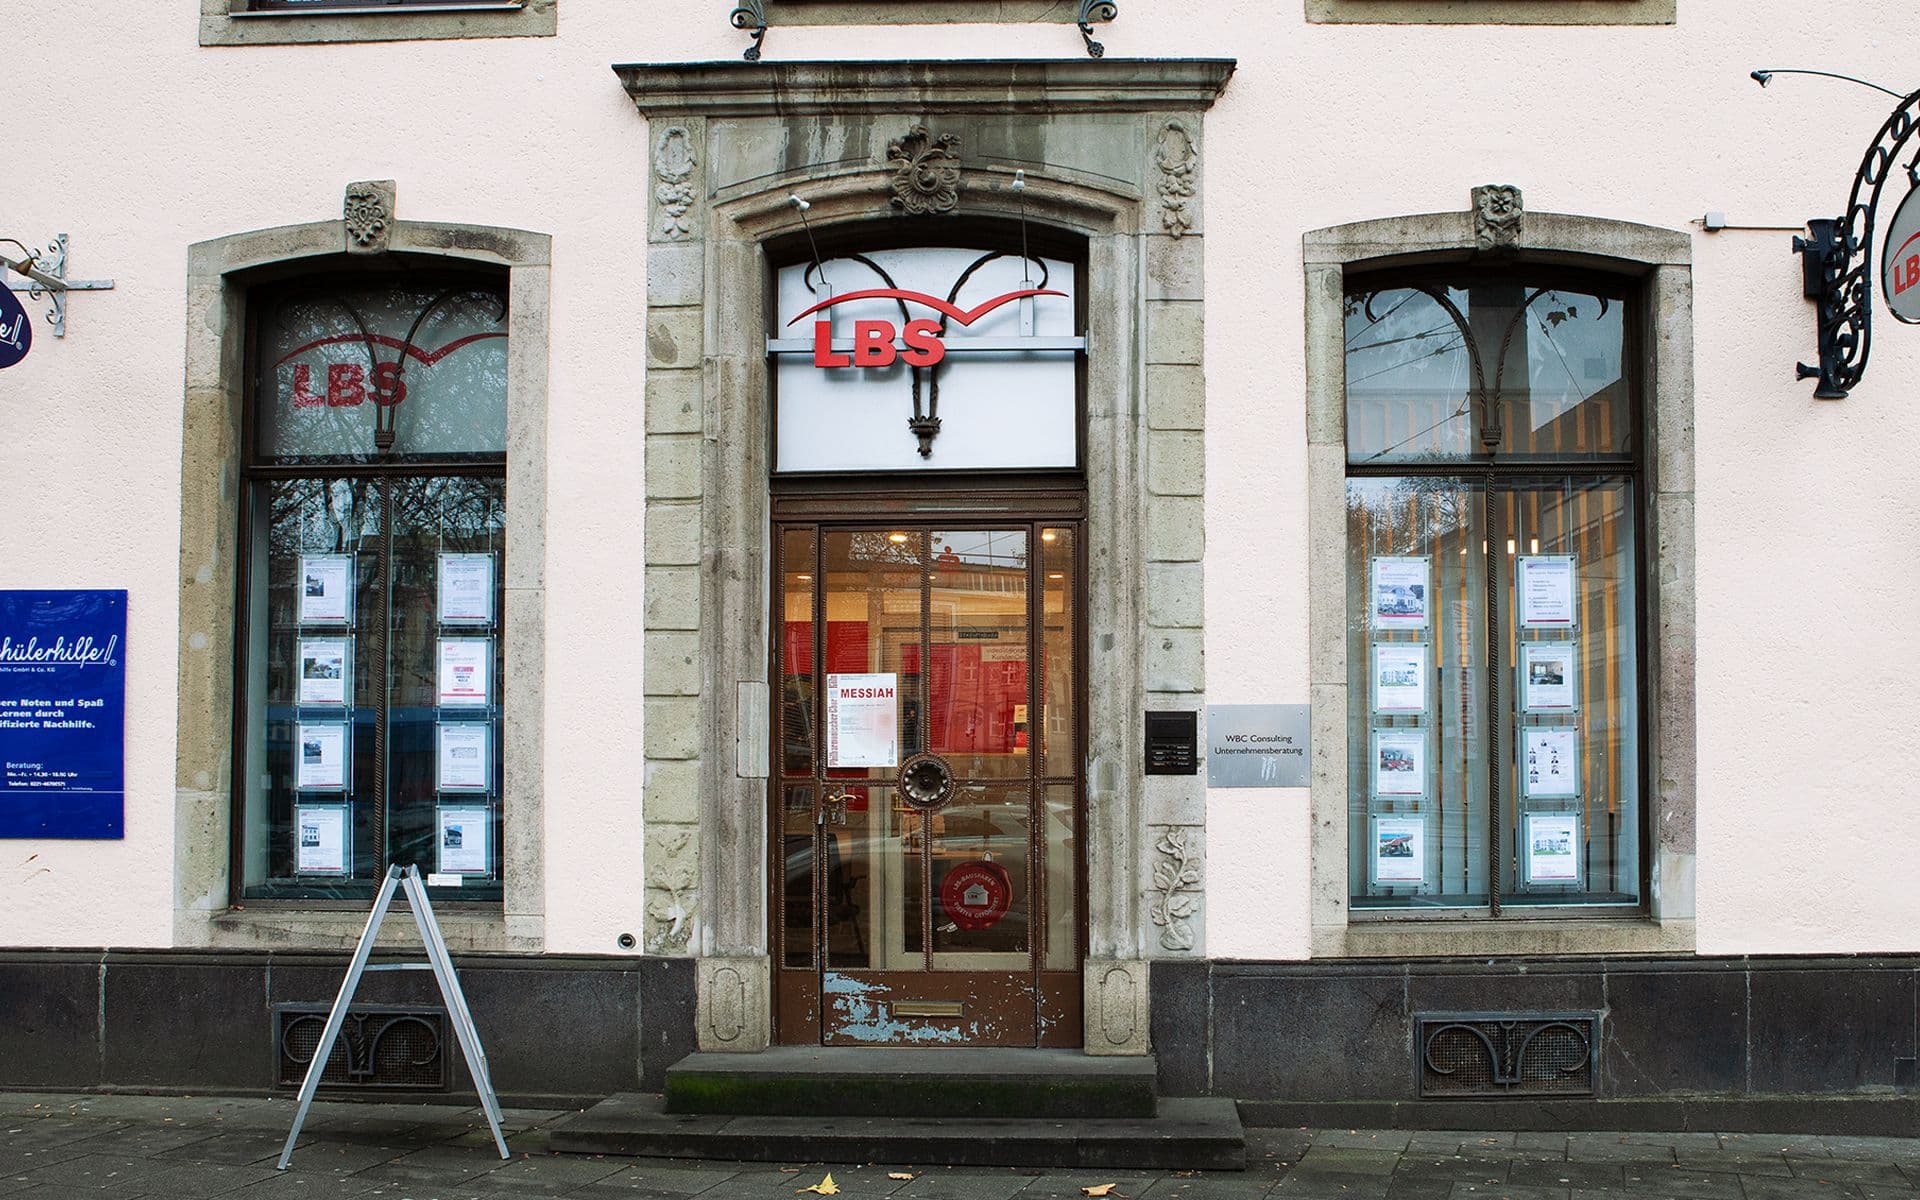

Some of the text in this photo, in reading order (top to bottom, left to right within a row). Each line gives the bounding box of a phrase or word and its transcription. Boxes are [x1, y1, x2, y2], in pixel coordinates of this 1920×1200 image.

[814, 319, 945, 368] LBS
[293, 361, 407, 408] LBS
[840, 688, 894, 698] MESSIAH
[21, 699, 51, 707] Noten
[55, 699, 74, 707] und
[78, 699, 104, 709] Spaß
[35, 709, 64, 718] durch
[43, 720, 96, 729] Nachhilfe.
[1250, 734, 1292, 744] Consulting
[1214, 747, 1303, 756] Unternehmensberatung
[6, 762, 43, 770] Beratung:
